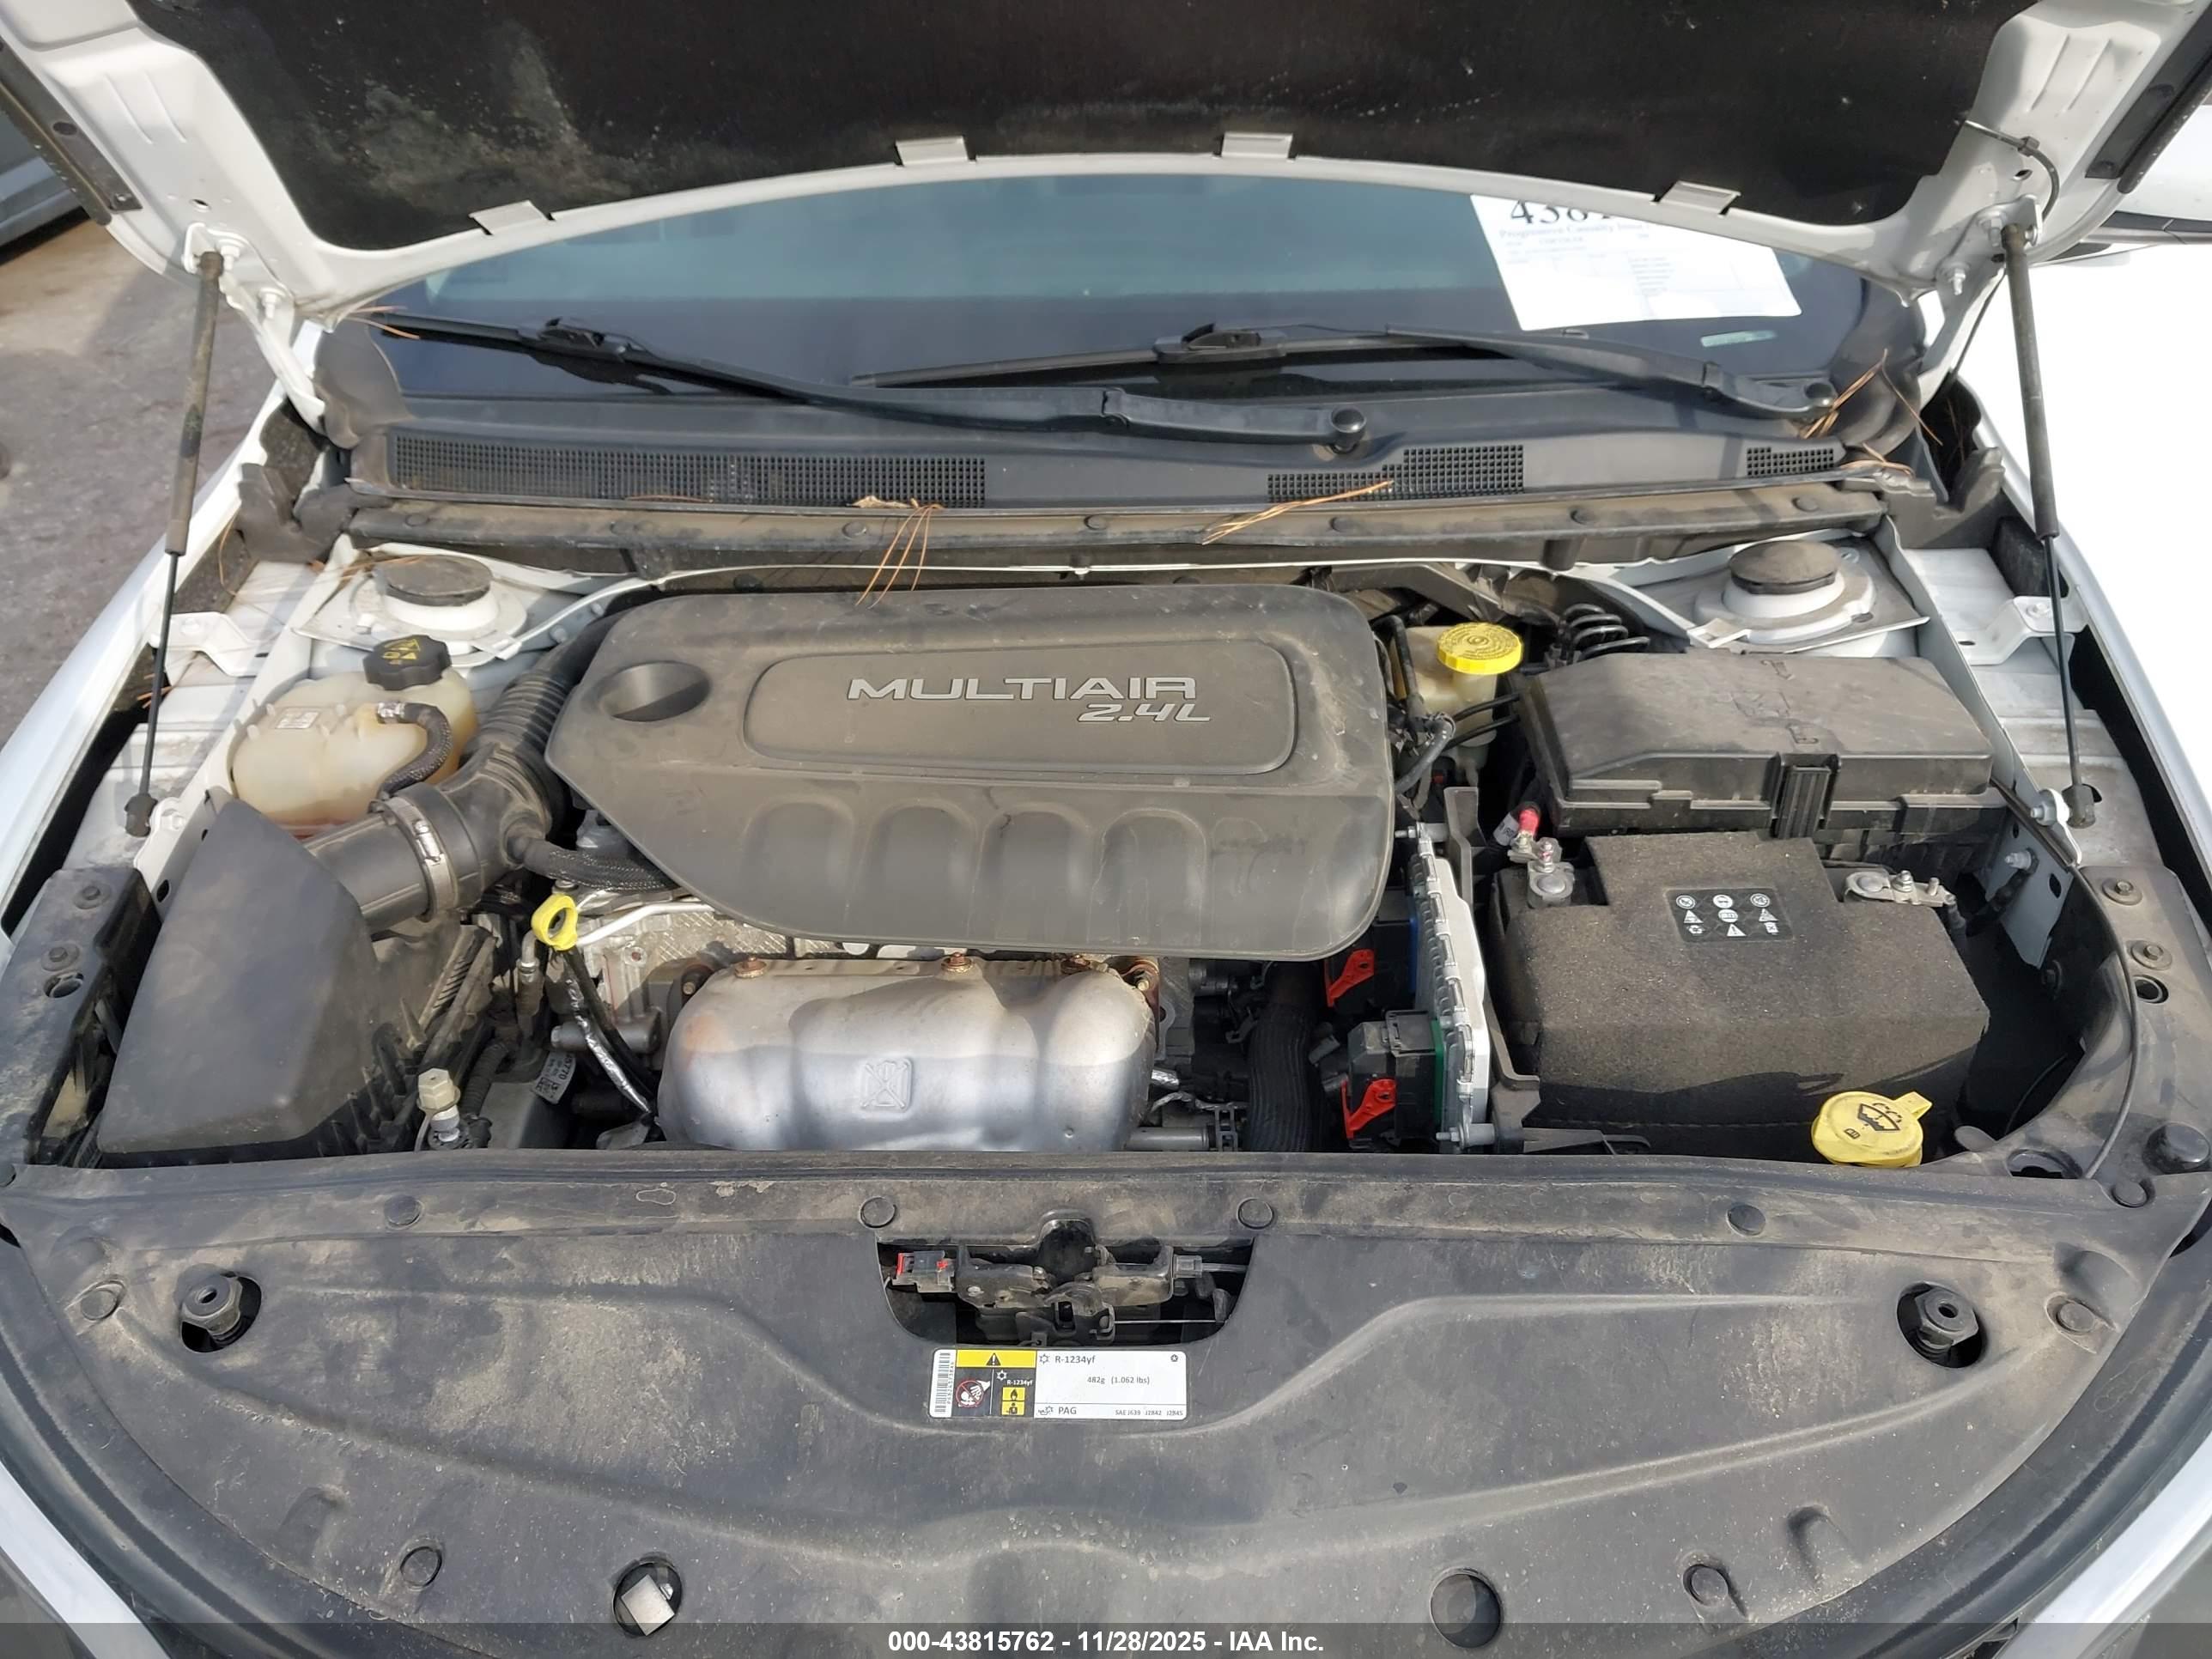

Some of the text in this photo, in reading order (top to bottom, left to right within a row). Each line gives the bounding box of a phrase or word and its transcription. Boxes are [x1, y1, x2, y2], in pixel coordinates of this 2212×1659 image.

[847, 677, 1197, 700] MULTIAIR
[1078, 703, 1211, 722] 2.4L
[1054, 1354, 1096, 1364] R-1234yf
[1087, 1376, 1151, 1384] 482g (1.062 lbs)
[1058, 1407, 1077, 1415] PAG
